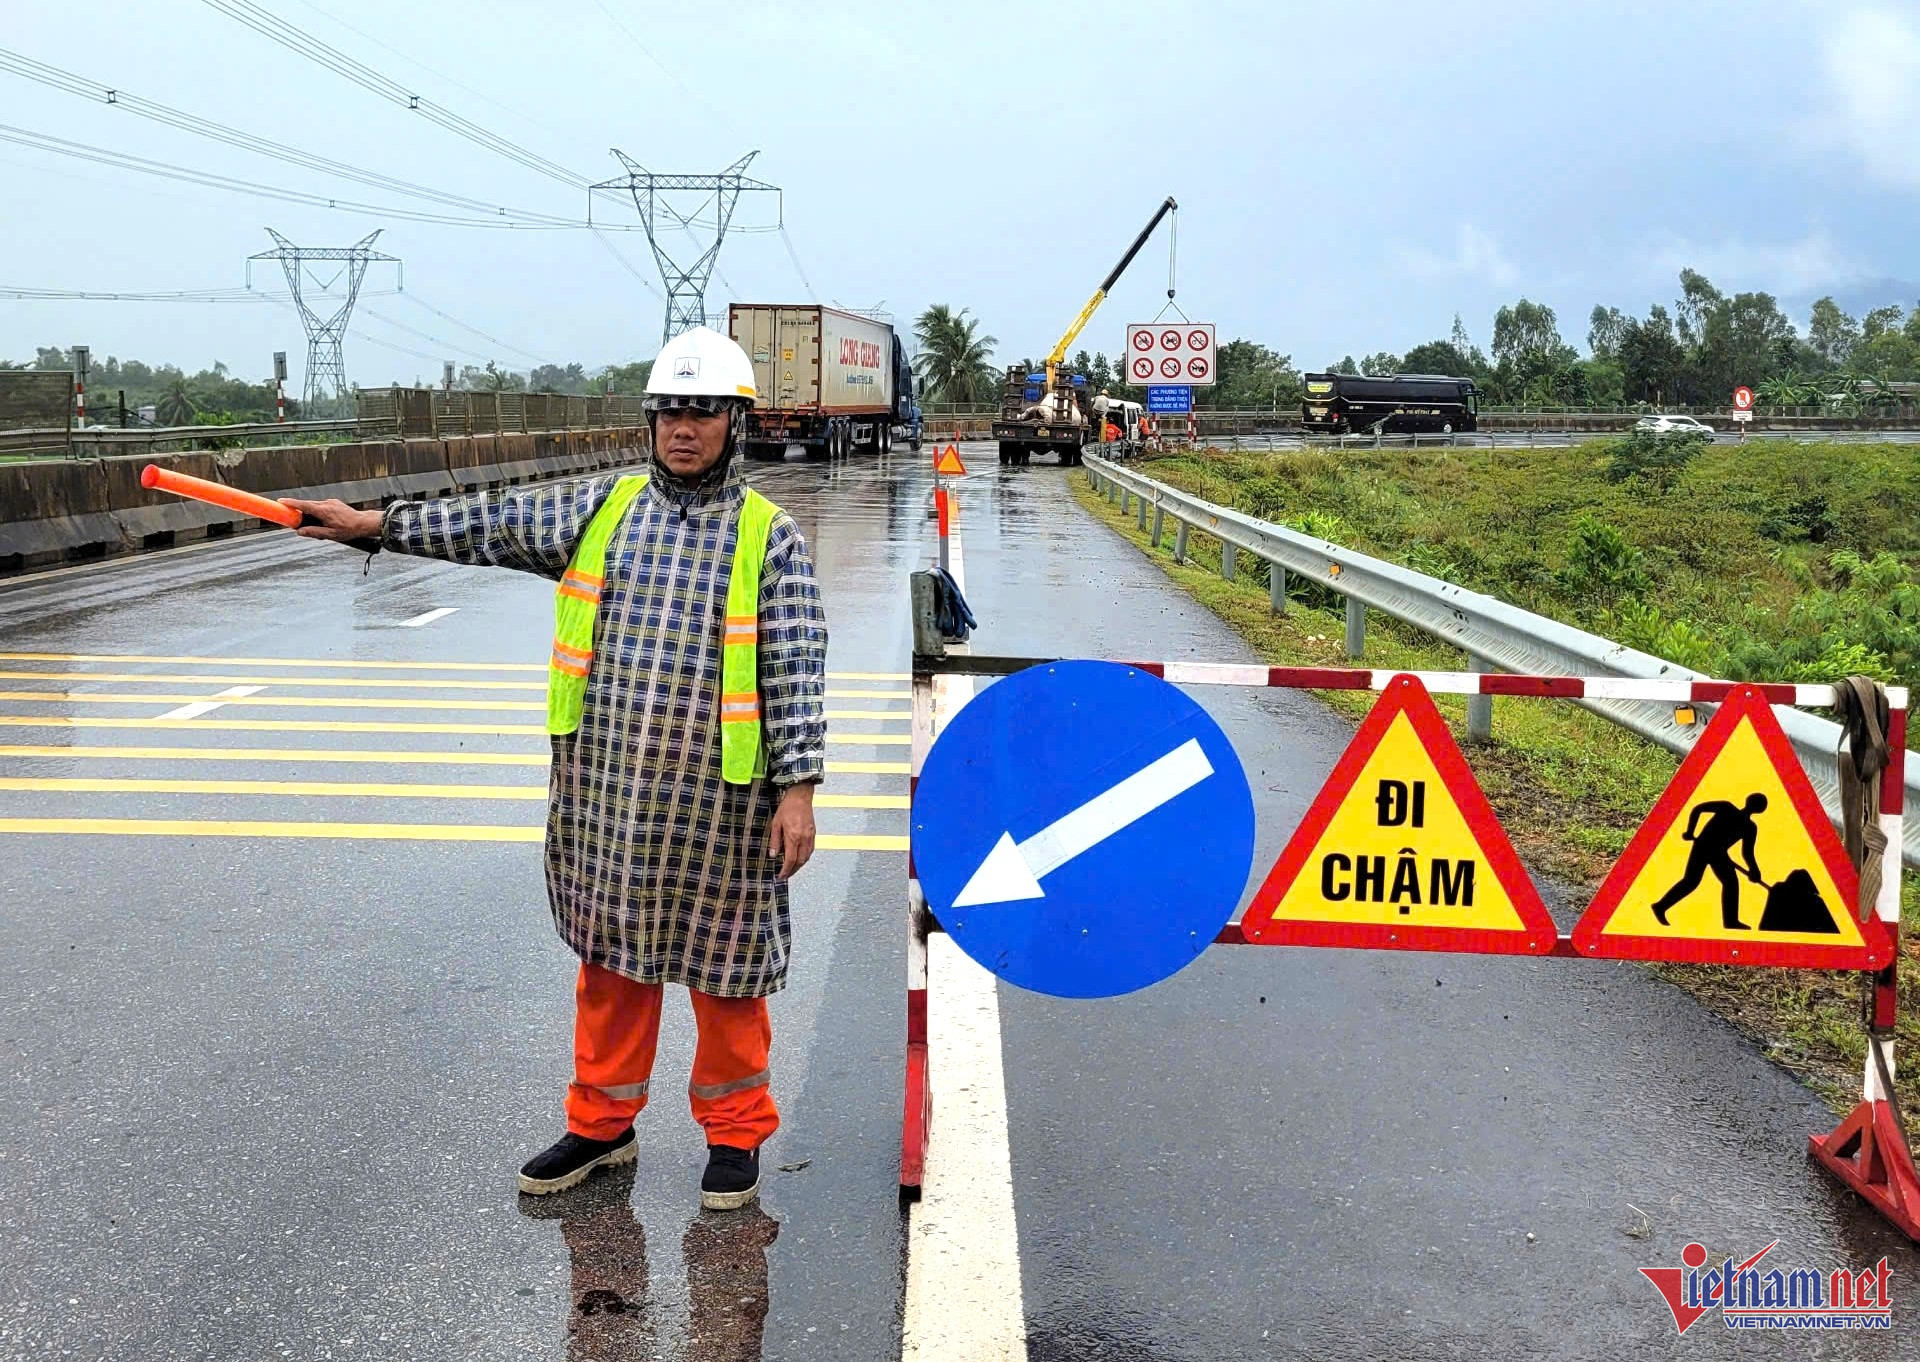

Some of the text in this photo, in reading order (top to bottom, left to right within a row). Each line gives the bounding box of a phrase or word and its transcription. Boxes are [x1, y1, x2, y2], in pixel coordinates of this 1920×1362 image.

[840, 336, 858, 366] LONG
[1375, 779, 1425, 828] ĐI
[1321, 847, 1475, 915] CHẬM
